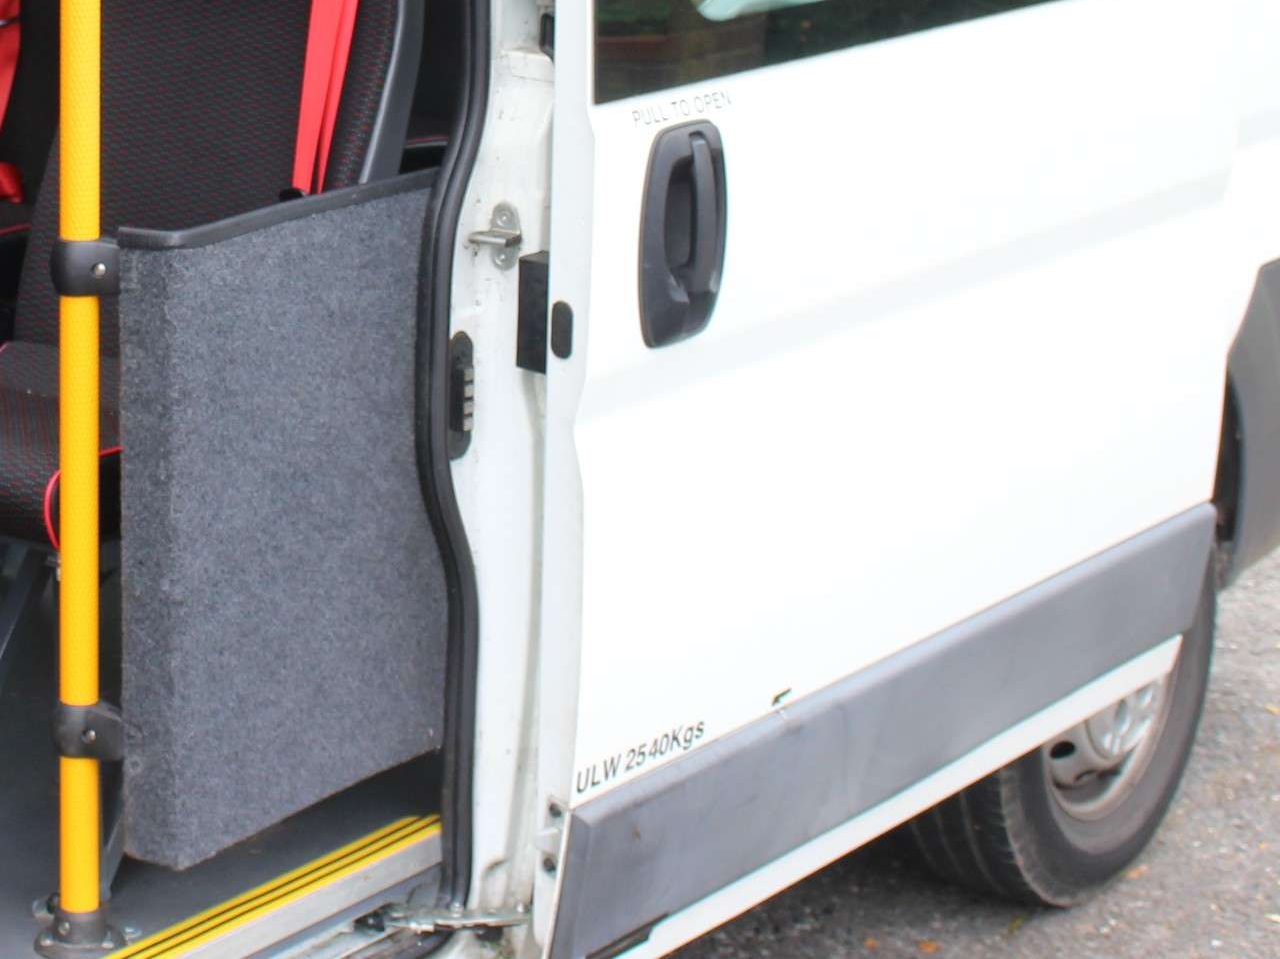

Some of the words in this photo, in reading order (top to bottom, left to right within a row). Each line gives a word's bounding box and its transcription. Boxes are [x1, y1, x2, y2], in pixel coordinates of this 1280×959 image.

[631, 104, 668, 128] PULL
[670, 99, 690, 116] TO
[694, 89, 732, 114] OPEN
[576, 753, 622, 793] ULW
[625, 721, 705, 771] 2540Kgs
